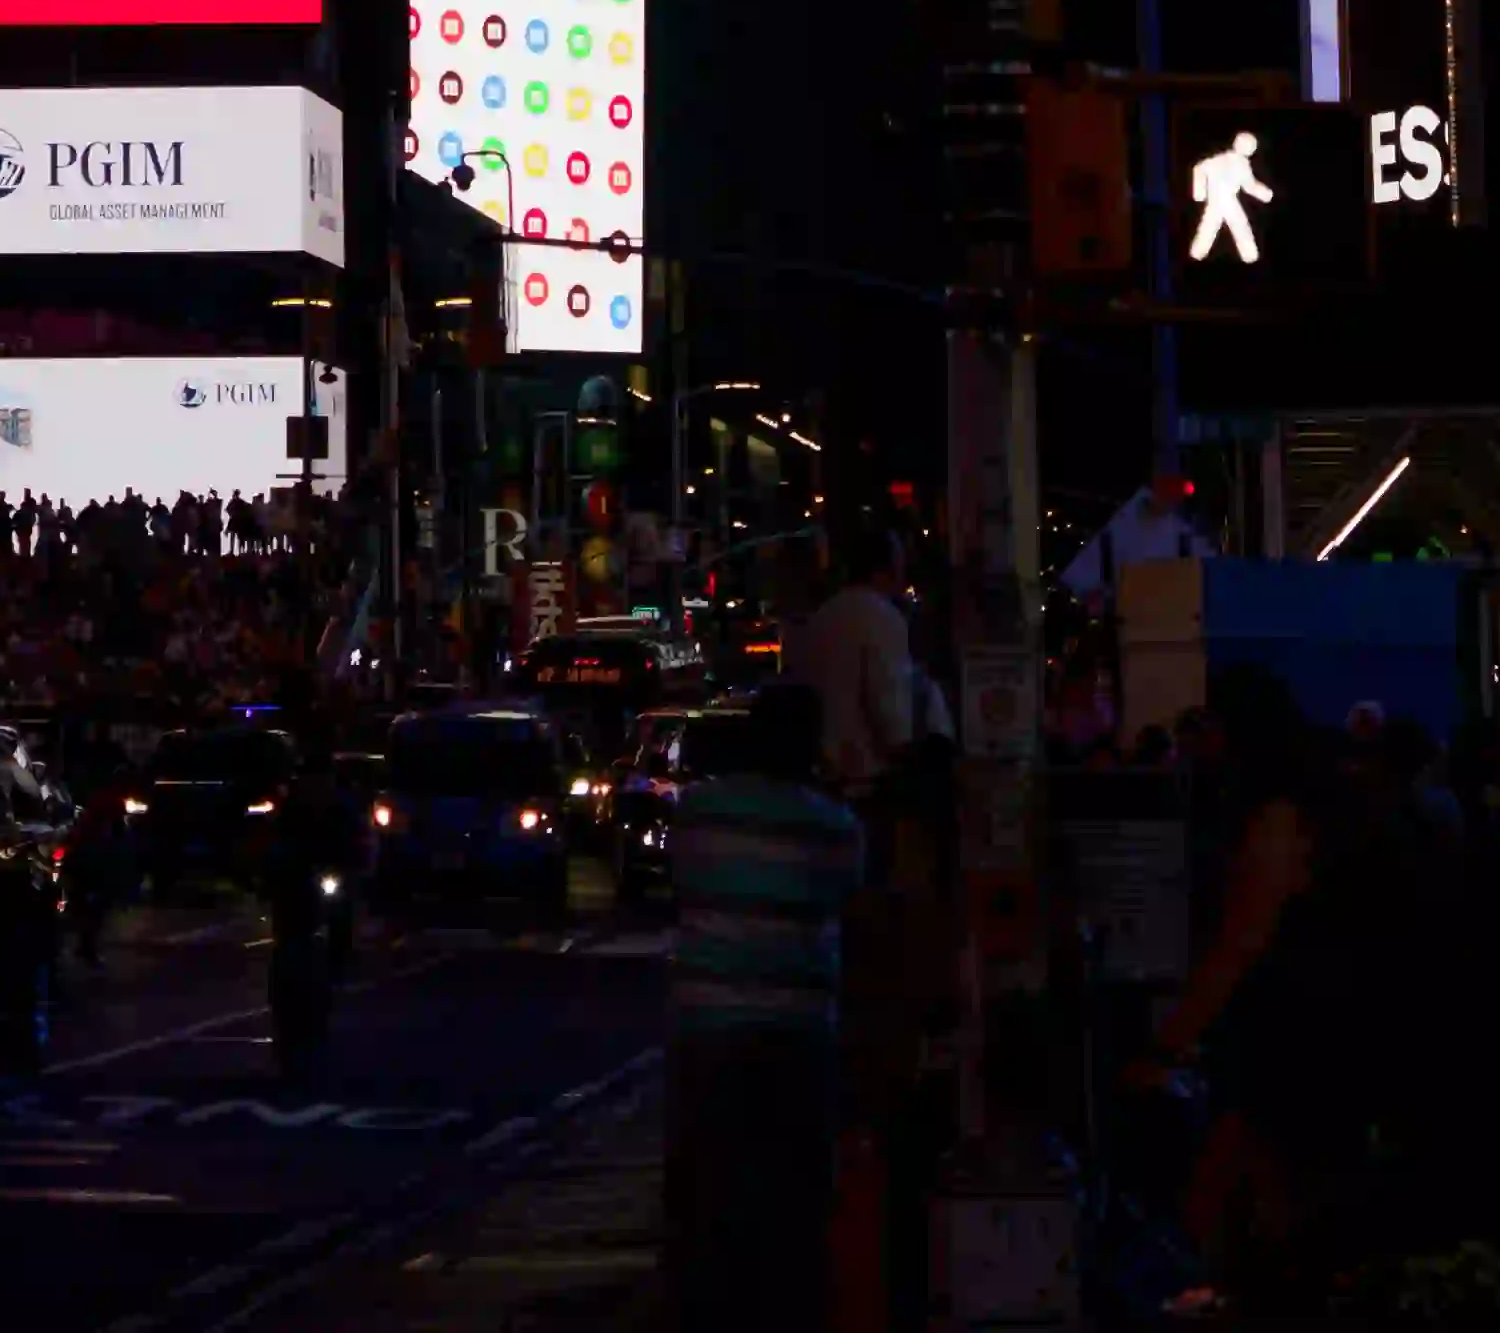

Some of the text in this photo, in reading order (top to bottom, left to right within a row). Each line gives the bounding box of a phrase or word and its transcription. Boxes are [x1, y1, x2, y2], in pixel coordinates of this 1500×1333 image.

[45, 141, 185, 187] PGIM
[1369, 105, 1451, 204] ES
[49, 202, 226, 220] GLOBAL ASSET MANAGEMENT
[215, 382, 277, 404] PGIM
